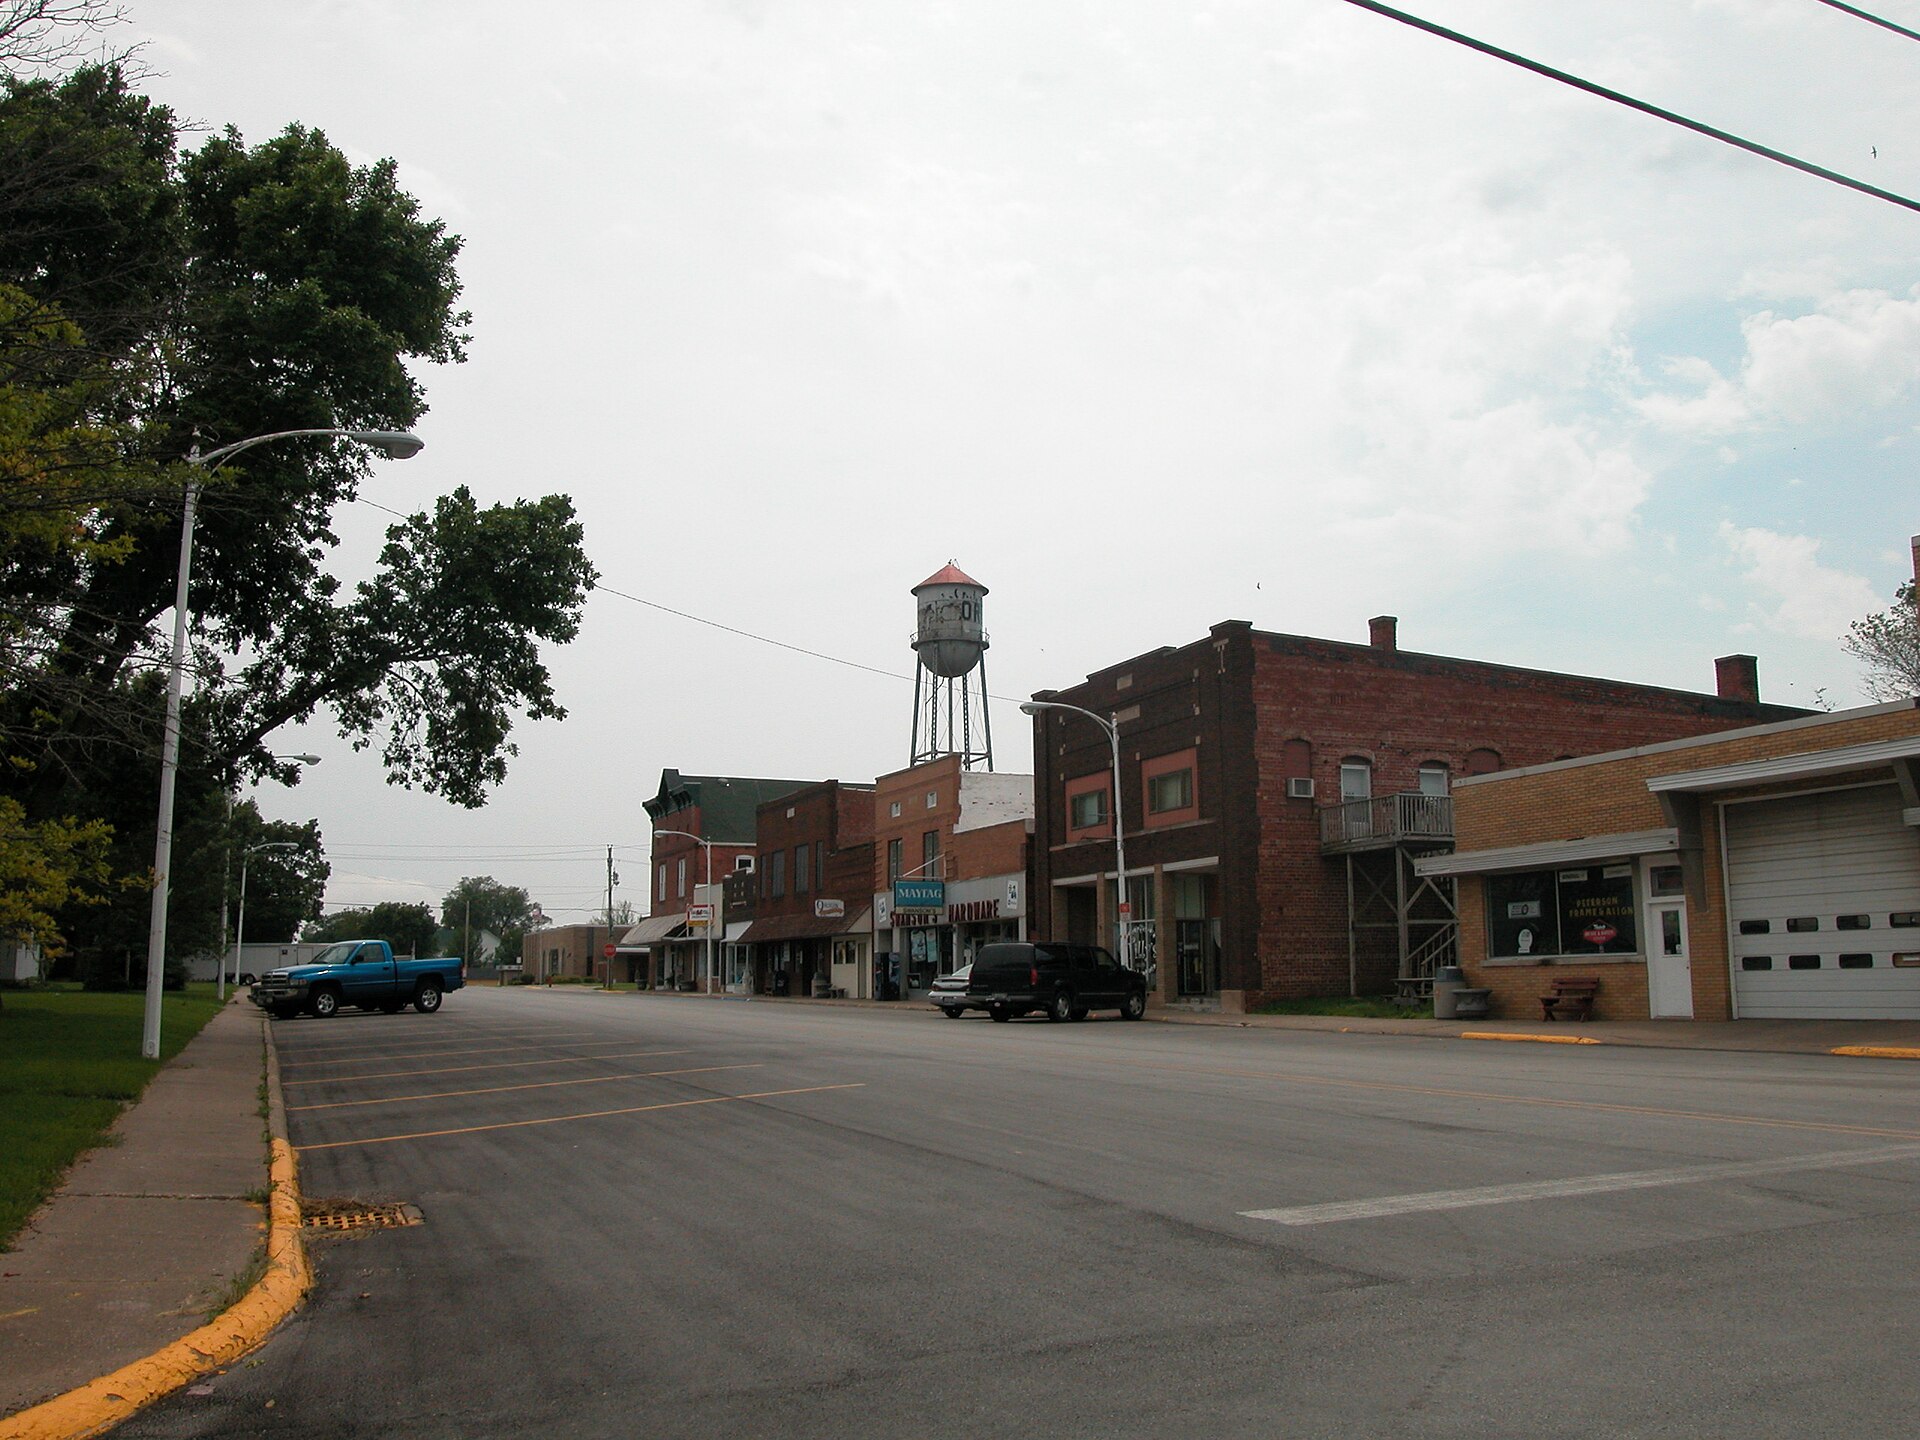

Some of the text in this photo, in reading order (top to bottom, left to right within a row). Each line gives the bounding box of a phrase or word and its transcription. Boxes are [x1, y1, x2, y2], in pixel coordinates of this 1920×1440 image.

[898, 888, 942, 898] MAYTAG
[1576, 896, 1618, 907] PETERSON
[890, 899, 1000, 927] SWANSONS HARDWARE
[1569, 907, 1596, 917] FRAME
